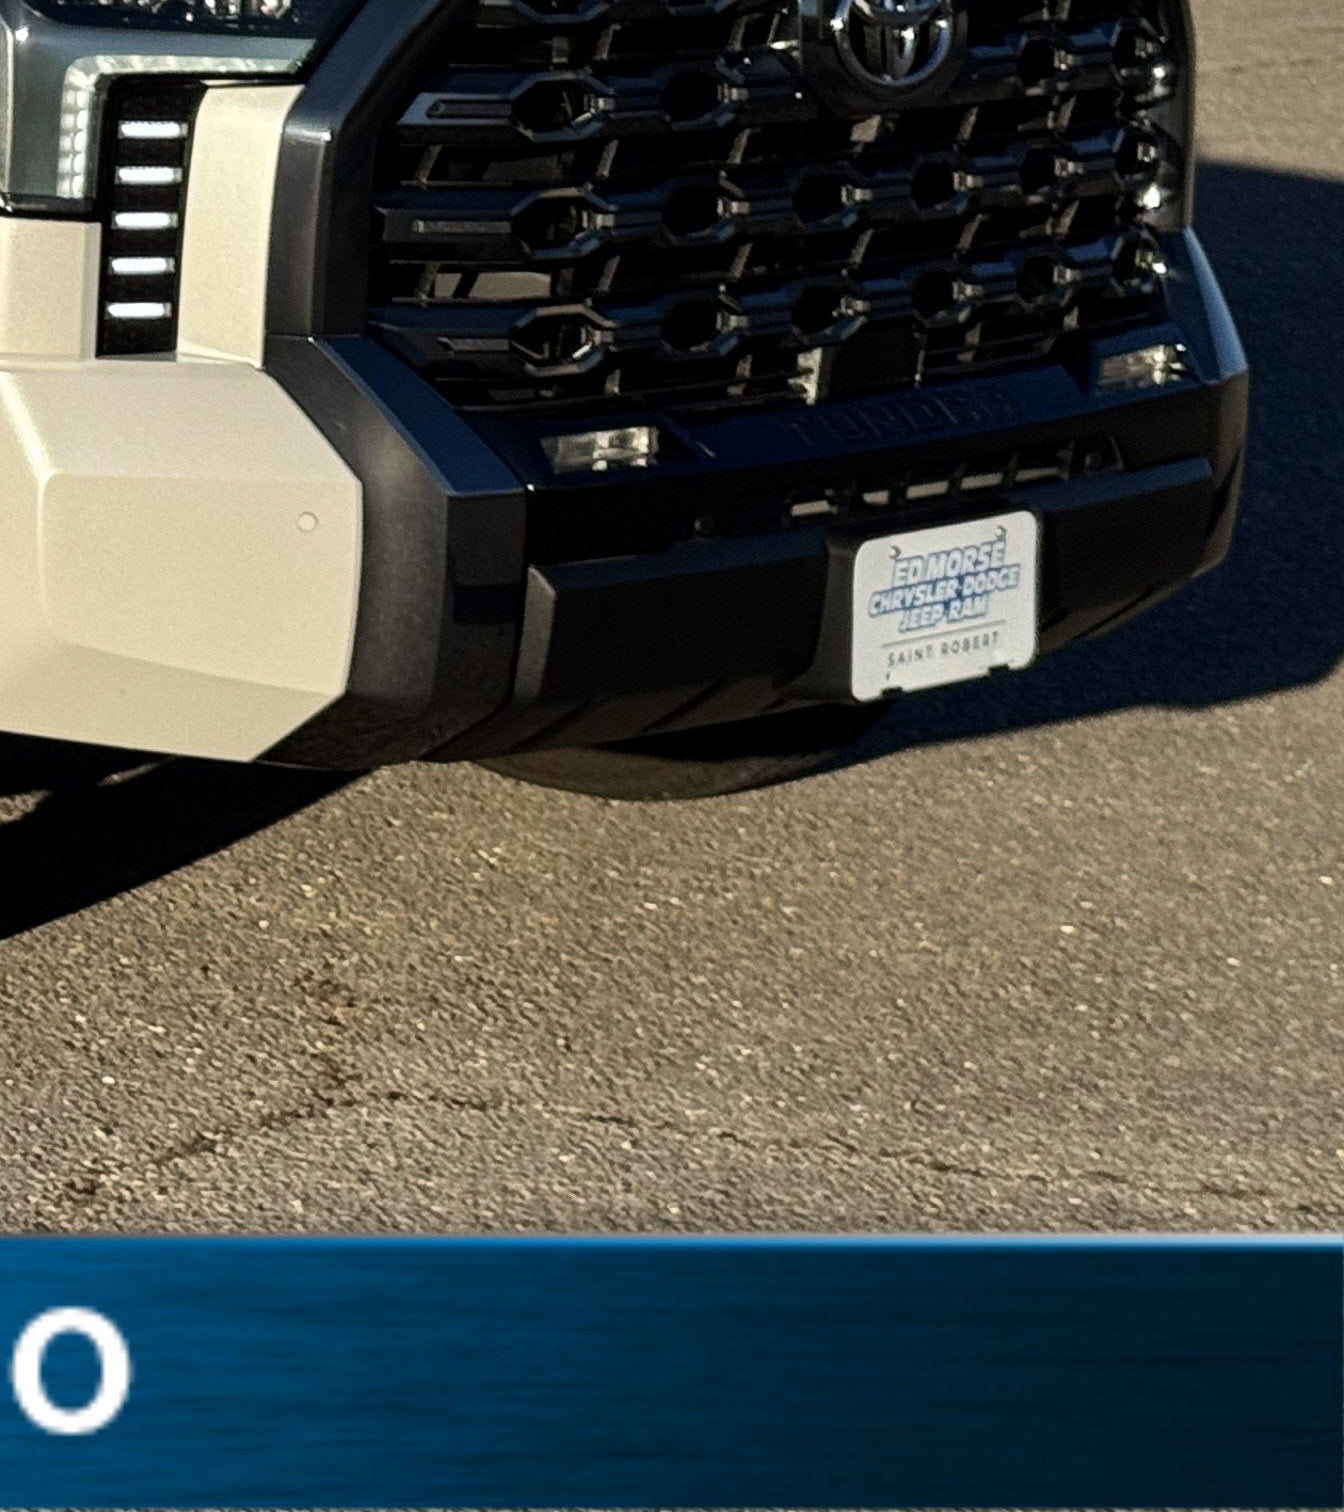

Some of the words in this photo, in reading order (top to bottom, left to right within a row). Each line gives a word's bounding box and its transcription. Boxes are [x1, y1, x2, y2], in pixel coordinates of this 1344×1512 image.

[892, 556, 926, 587] ED
[926, 539, 1006, 581] MORSE
[868, 578, 960, 617] CHRYSLER
[961, 563, 1021, 595] DODGE
[898, 605, 943, 633] JEEP
[945, 594, 989, 623] RAM
[887, 644, 934, 667] SAINT
[941, 630, 1000, 655] ROBERT
